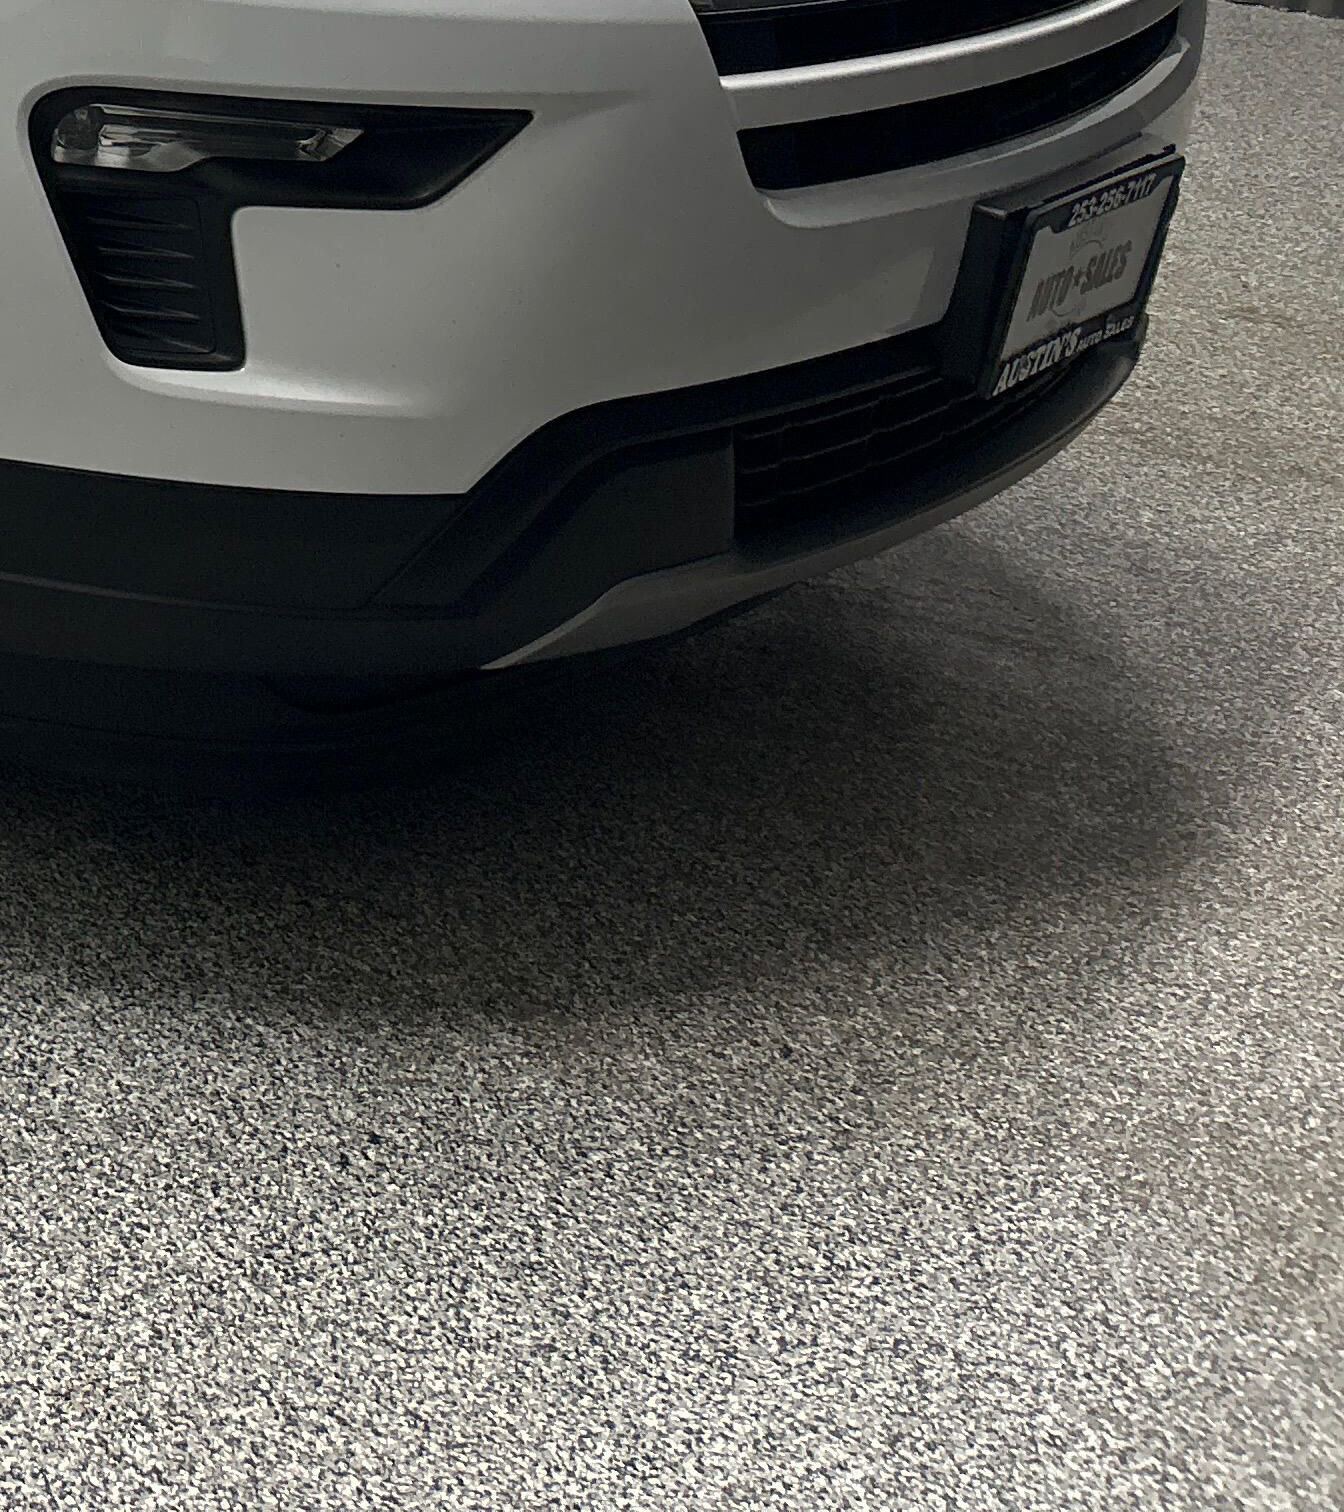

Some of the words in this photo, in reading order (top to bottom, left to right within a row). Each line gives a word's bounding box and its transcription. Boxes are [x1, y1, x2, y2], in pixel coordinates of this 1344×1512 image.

[1067, 171, 1158, 227] 253-256-7117
[1025, 264, 1075, 323] AUTO
[1079, 239, 1133, 296] SALES
[991, 326, 1082, 397] AUSTIN'S
